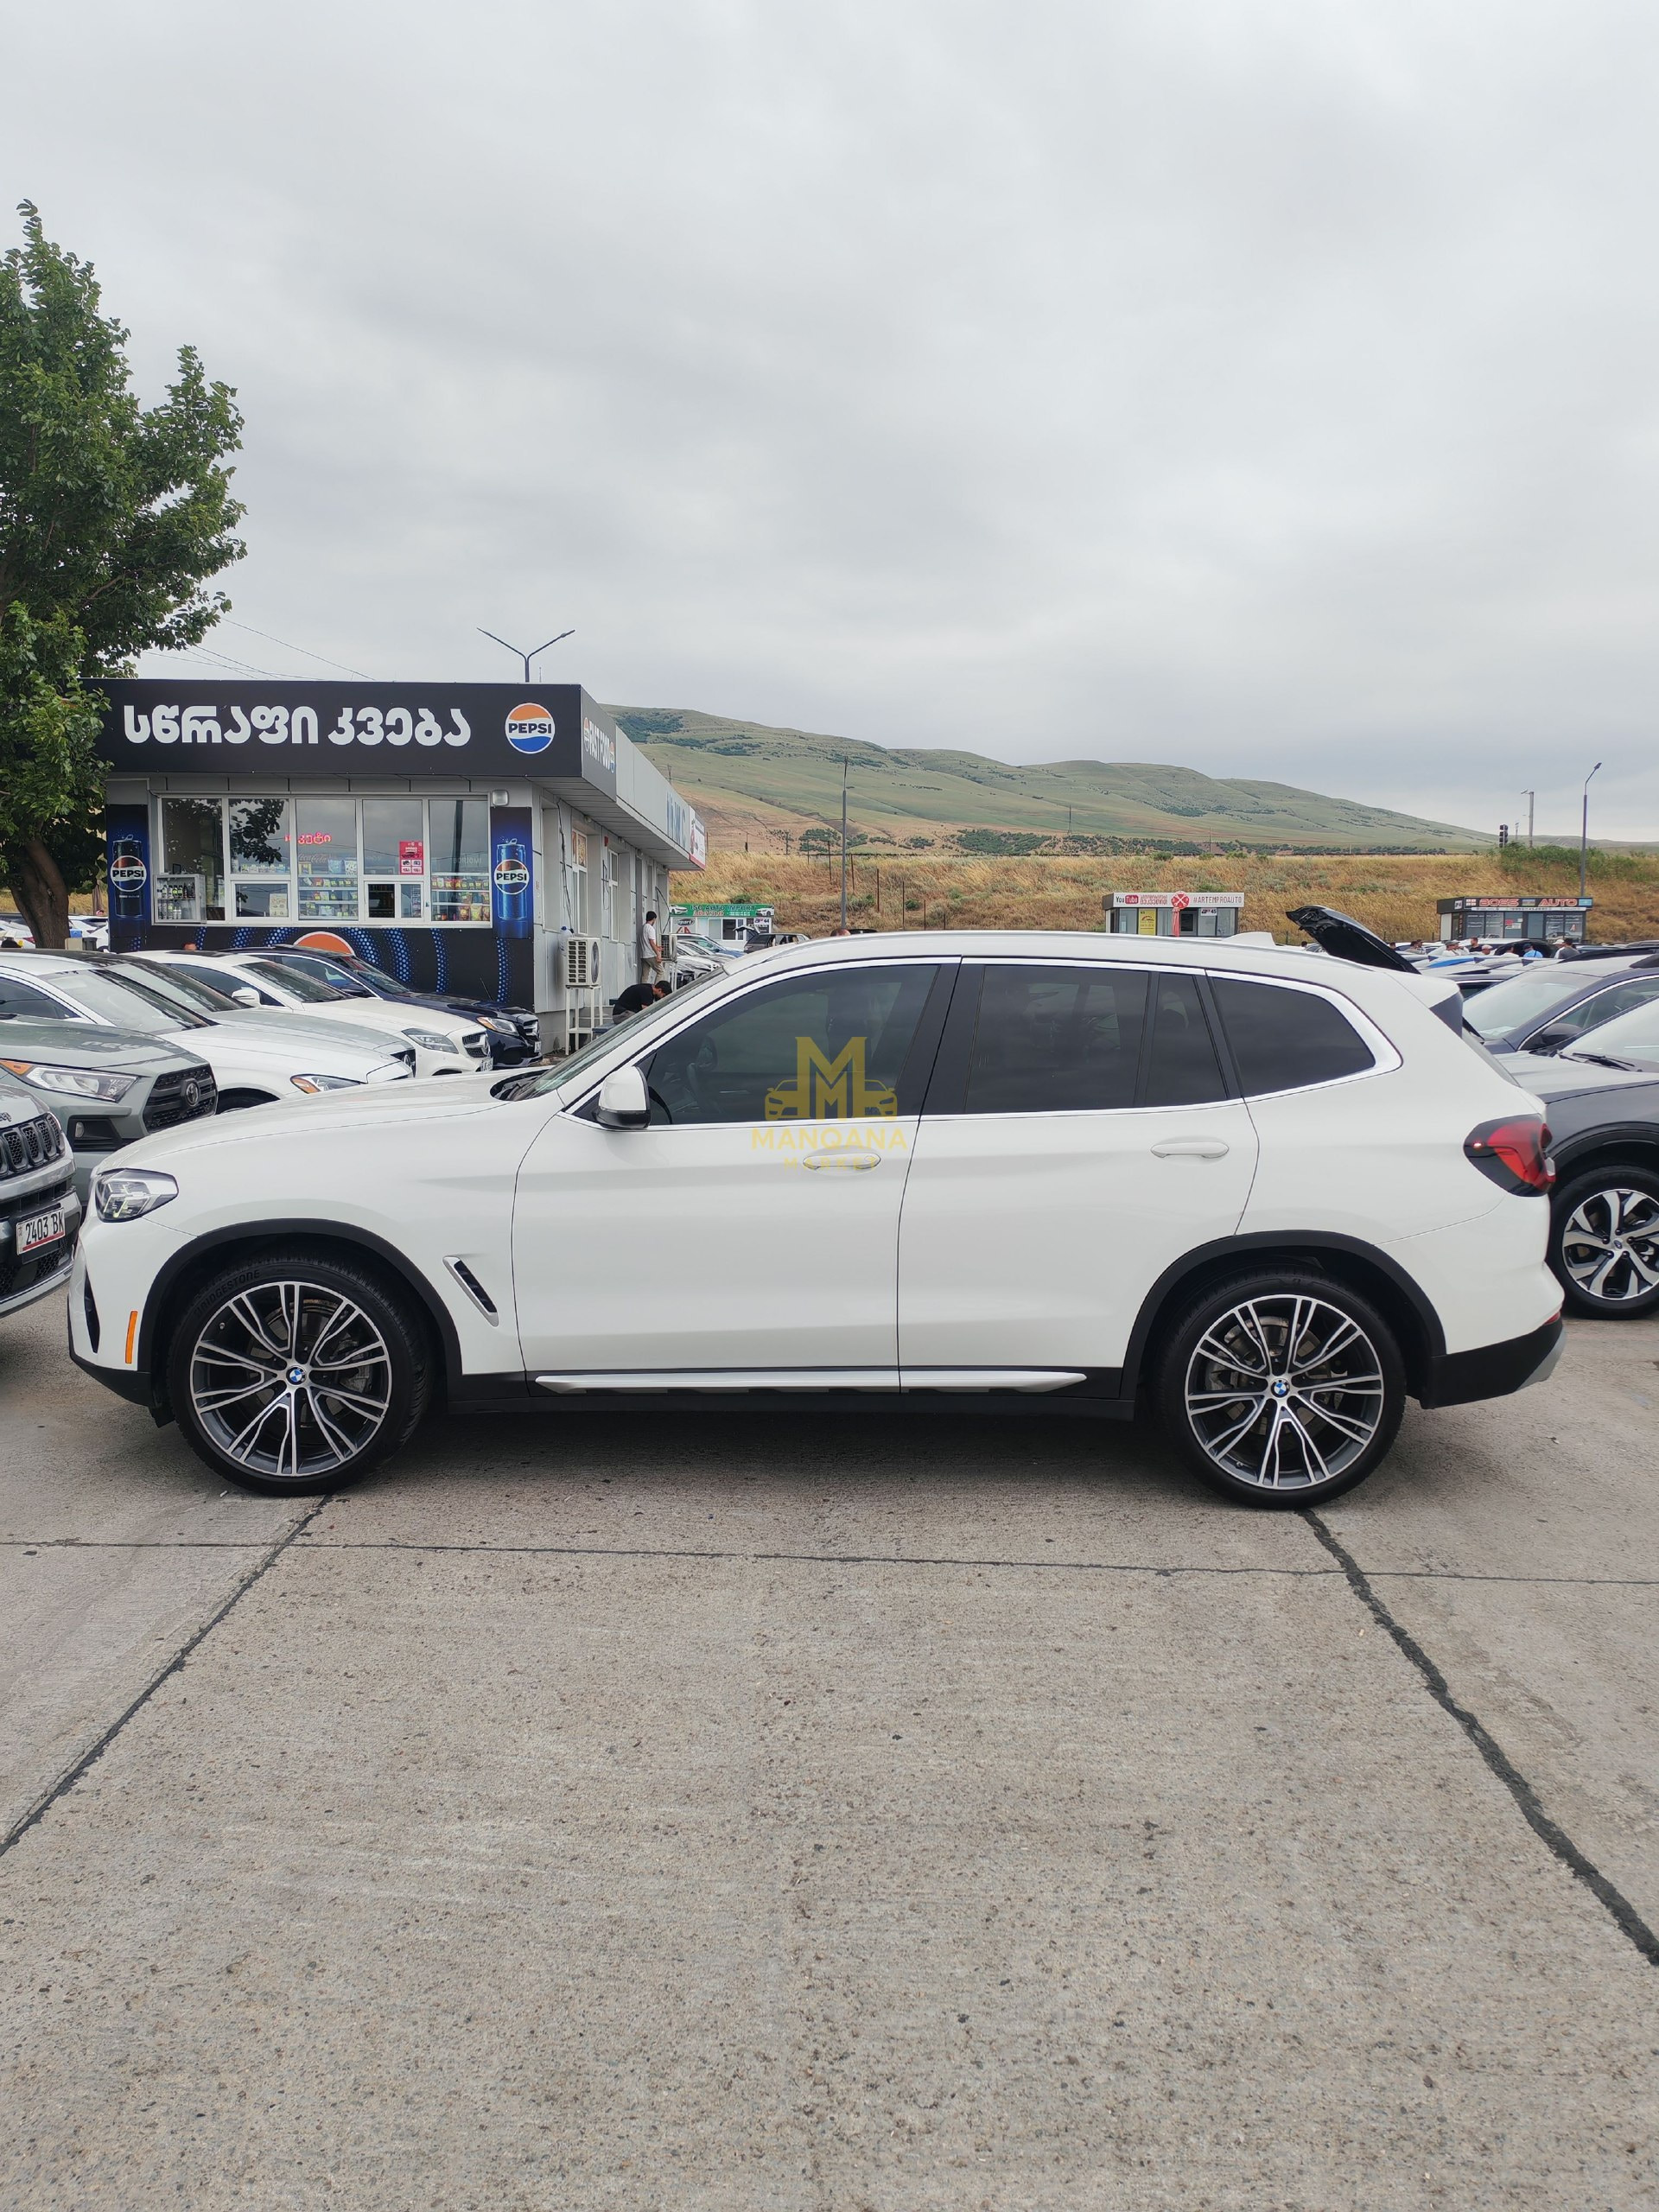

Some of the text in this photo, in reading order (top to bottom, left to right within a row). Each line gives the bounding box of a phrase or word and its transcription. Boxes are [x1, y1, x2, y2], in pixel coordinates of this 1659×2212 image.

[124, 704, 472, 747] სწრაფი კვება
[508, 722, 552, 734] PEPSI
[111, 869, 144, 878] PEPSI
[496, 873, 527, 881] PEPSI
[1478, 899, 1578, 907] BOSS AUTO
[25, 1216, 49, 1246] 2403
[50, 1211, 65, 1235] BK
